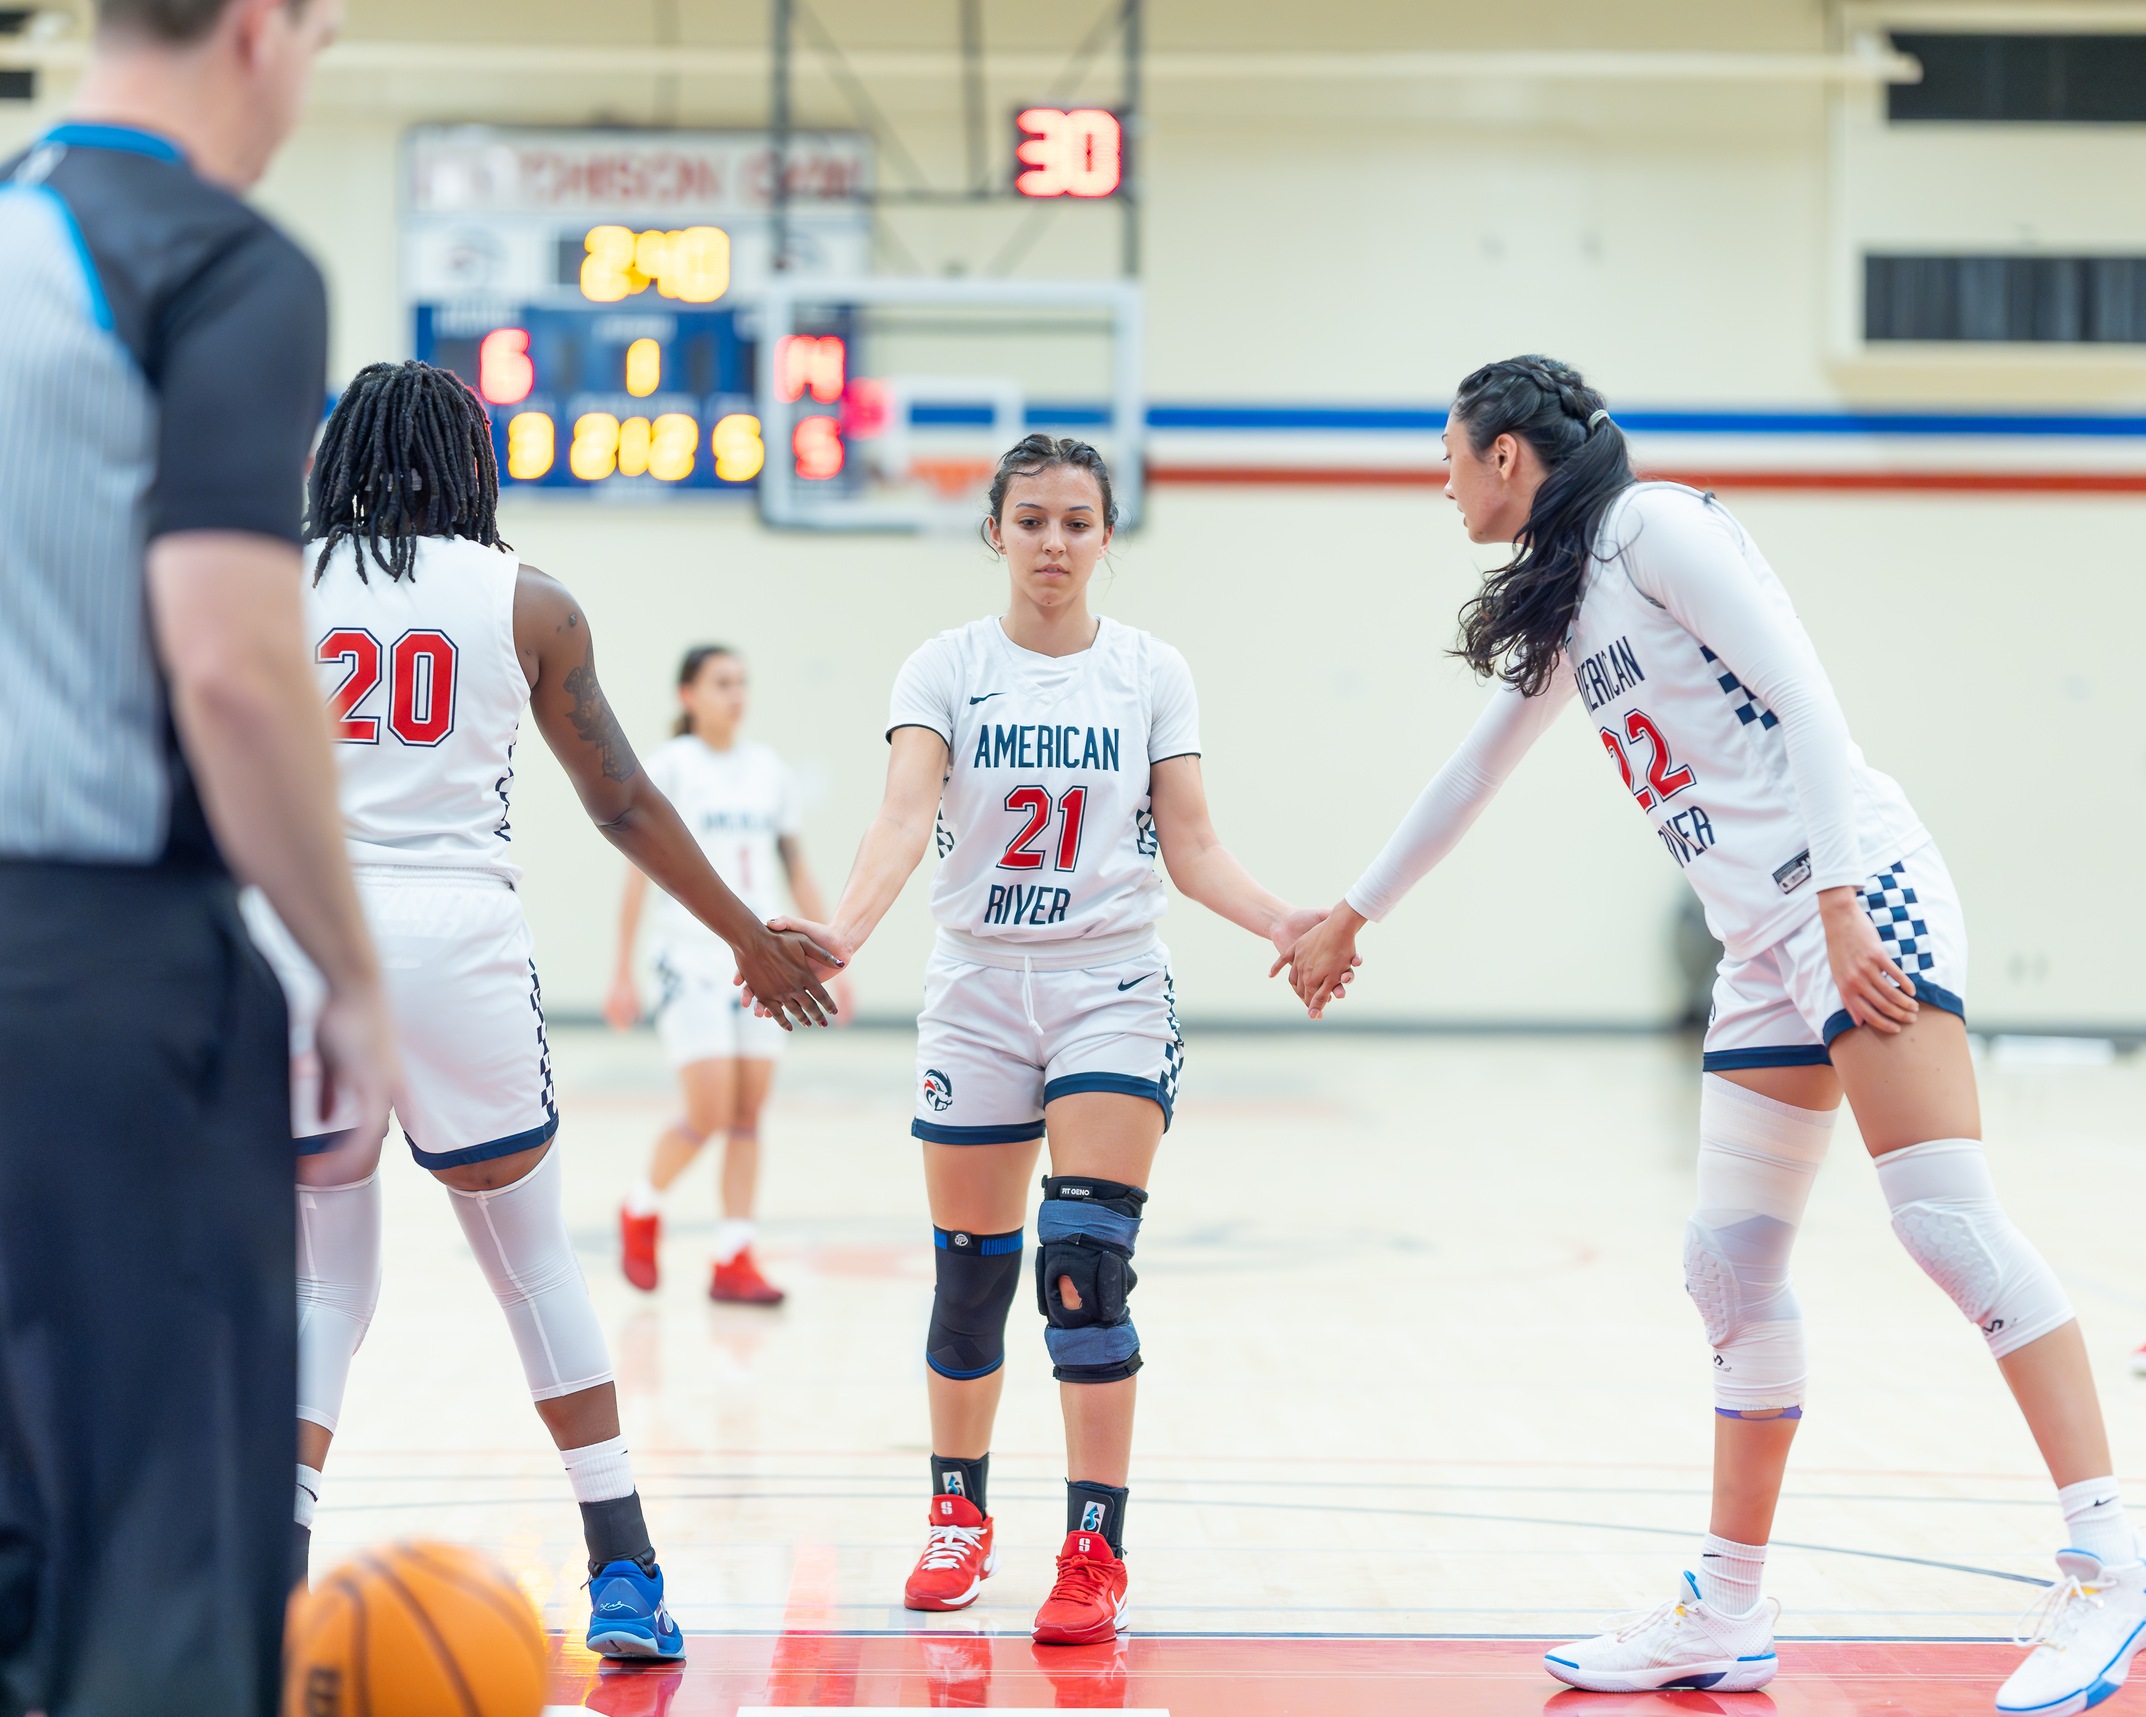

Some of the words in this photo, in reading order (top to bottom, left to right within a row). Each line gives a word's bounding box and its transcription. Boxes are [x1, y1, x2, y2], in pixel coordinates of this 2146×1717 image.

[1016, 108, 1121, 198] 30
[480, 328, 534, 404] 6
[626, 338, 660, 397] 1
[315, 627, 459, 748] 20
[973, 724, 1120, 772] AMERICAN
[1599, 708, 1697, 814] 22
[995, 784, 1088, 873] 21
[984, 884, 1071, 925] RIVER
